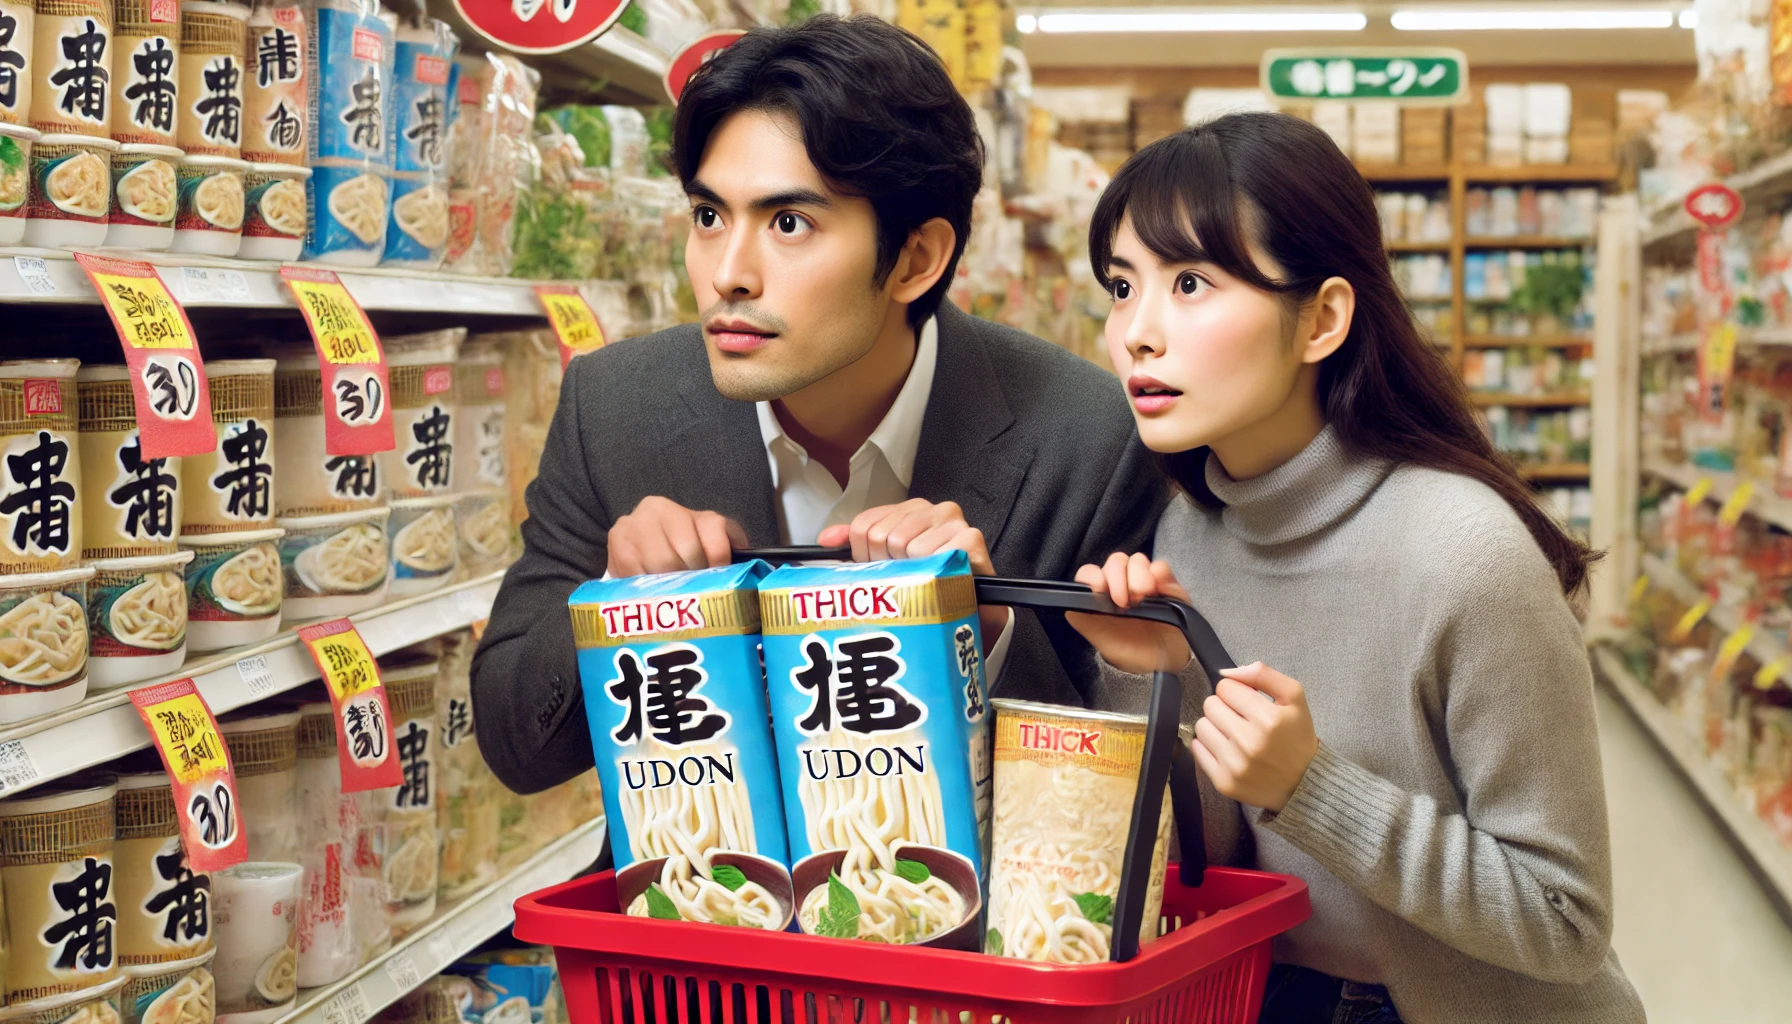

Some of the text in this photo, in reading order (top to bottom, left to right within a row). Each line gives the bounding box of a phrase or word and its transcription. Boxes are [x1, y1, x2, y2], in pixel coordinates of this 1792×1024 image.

[602, 598, 700, 634] THICK
[792, 585, 897, 619] THICK
[1019, 724, 1100, 756] THICK
[621, 753, 734, 790] UDON
[802, 745, 925, 780] UDON
